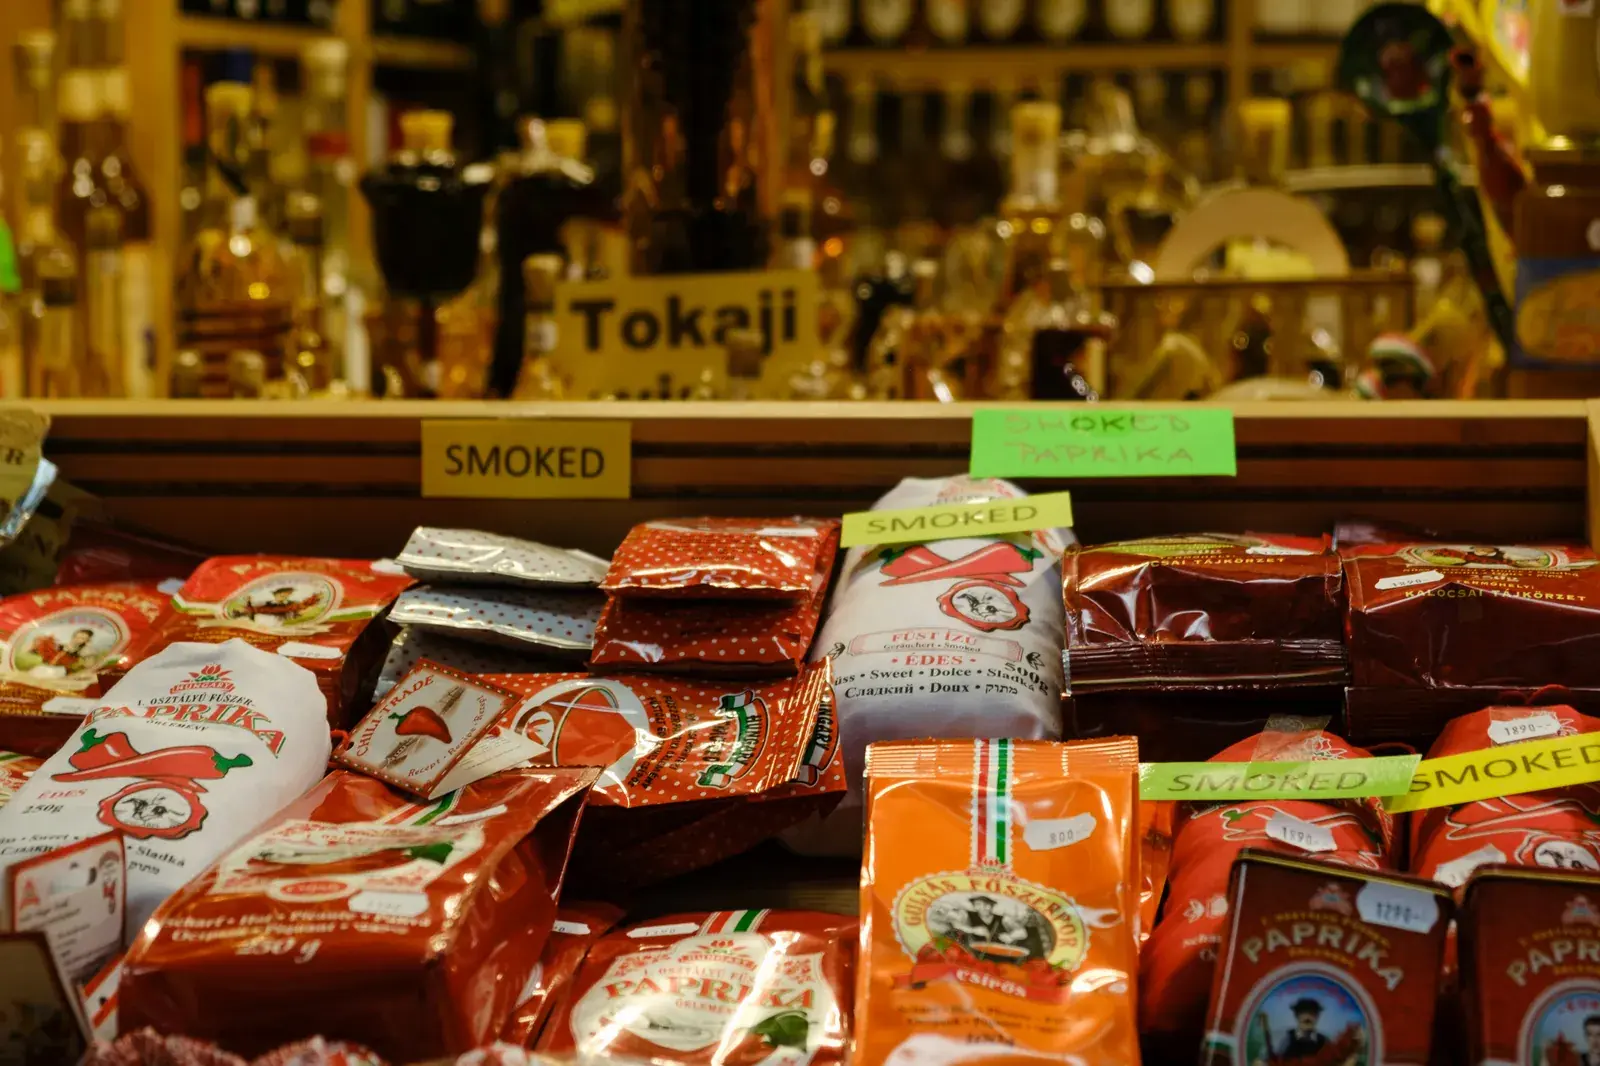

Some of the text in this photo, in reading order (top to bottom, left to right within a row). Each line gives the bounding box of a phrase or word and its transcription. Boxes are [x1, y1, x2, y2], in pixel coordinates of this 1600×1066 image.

[570, 287, 798, 356] Tokaji
[444, 446, 605, 478] SMOKED
[866, 505, 1039, 534] SMOKED
[1404, 589, 1484, 598] KALOCSAI
[905, 652, 963, 666] ÉDES
[833, 675, 856, 687] üss
[869, 669, 913, 680] Sweet
[929, 667, 972, 678] Dolce
[844, 685, 914, 699] Сладкий
[929, 682, 970, 693] Doux
[1004, 661, 1050, 696] 500g
[81, 703, 287, 760] PAPRIKA
[356, 674, 435, 757] CHILI-TRADE
[737, 714, 762, 766] HUNGARY
[1167, 771, 1368, 793] SMOKED
[904, 878, 957, 927] GULYÁS
[1241, 921, 1405, 992] PAPRIKA
[602, 975, 815, 1009] PAPRIKA
